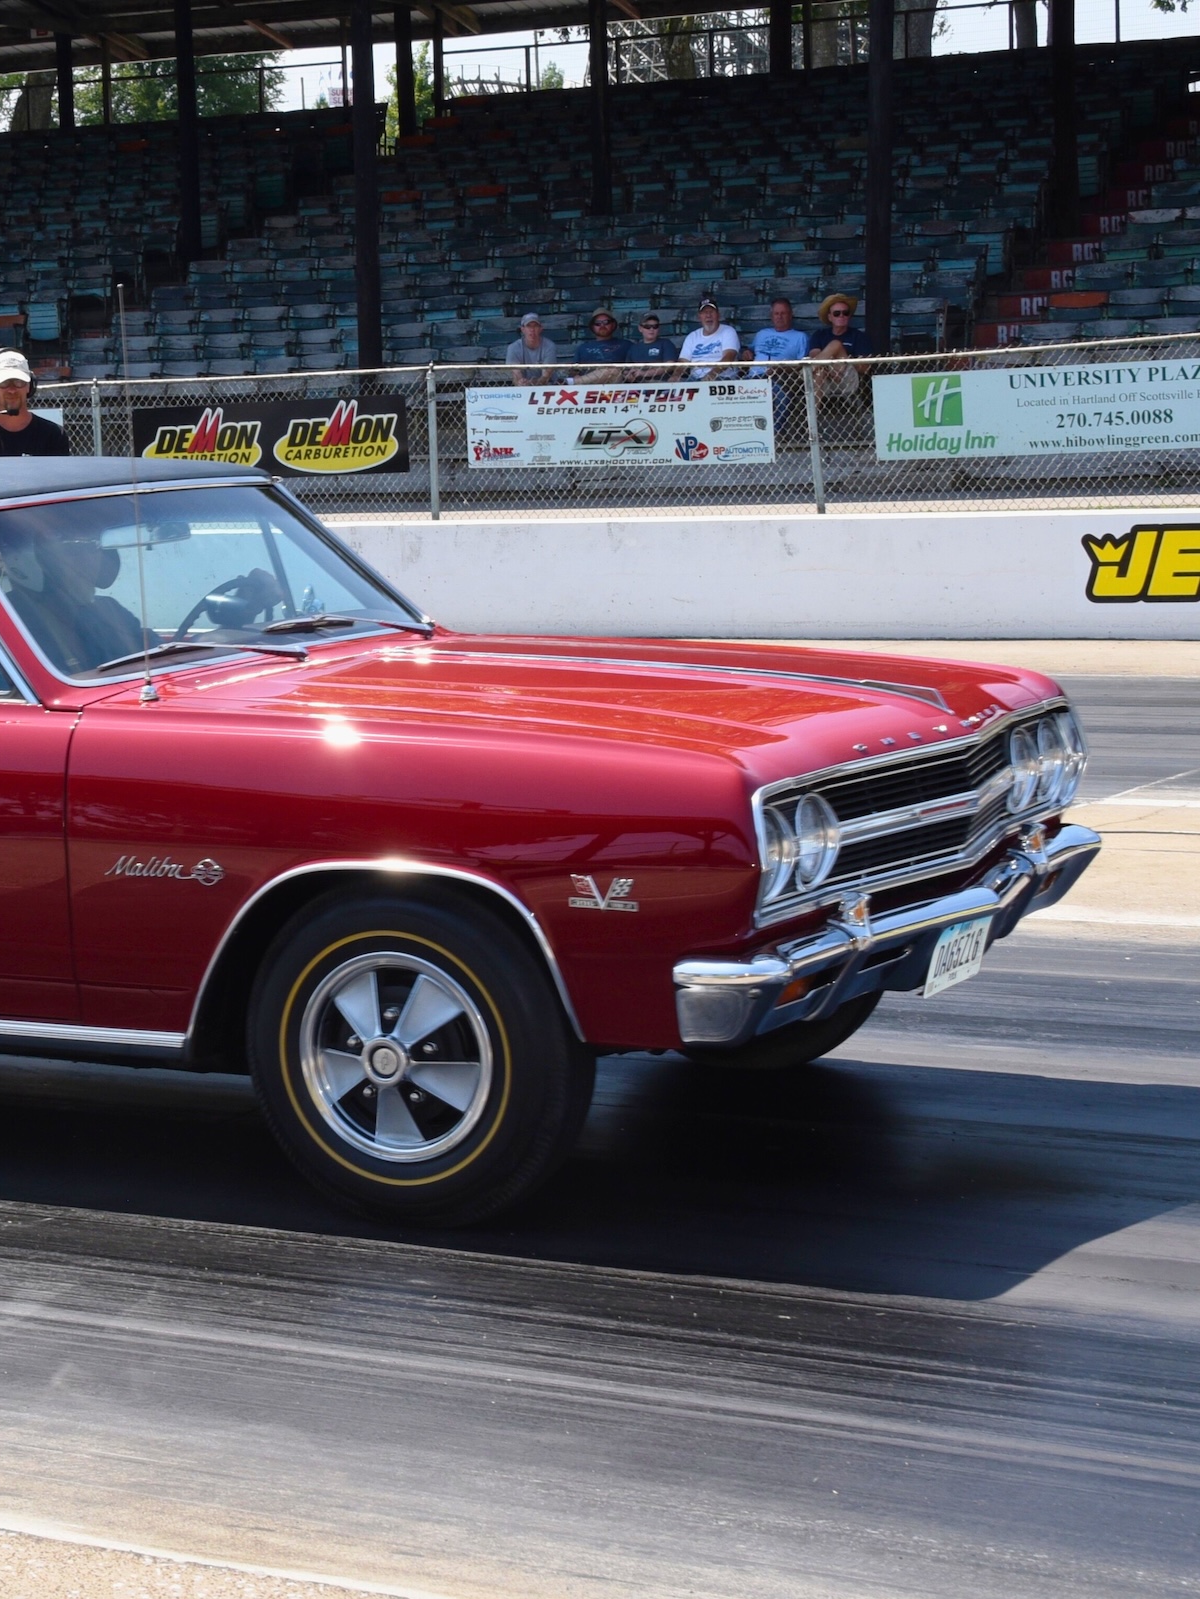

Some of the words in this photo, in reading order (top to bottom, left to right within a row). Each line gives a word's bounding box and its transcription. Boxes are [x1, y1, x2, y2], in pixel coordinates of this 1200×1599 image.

[1009, 368, 1142, 389] UNIVERSITY
[528, 389, 580, 405] LTX
[584, 388, 699, 404] SHOOTOUT
[709, 385, 736, 396] BDB
[738, 386, 767, 397] Racing
[1016, 397, 1056, 408] Located
[1059, 397, 1069, 406] in
[1072, 393, 1116, 405] Hartland
[1119, 392, 1137, 403] Off
[1139, 389, 1193, 402] Scottsville
[537, 406, 607, 415] SEPTEMBER
[648, 404, 686, 413] 2019
[1056, 408, 1174, 428] 270.745.0088
[155, 411, 259, 454] DEMON
[286, 405, 396, 447] DEMON
[675, 436, 698, 461] VP
[886, 432, 962, 455] Holiday
[965, 430, 996, 449] Inn
[1029, 433, 1200, 449] www.hibowlinggreen.com
[284, 445, 388, 461] CARBURETION
[560, 458, 672, 466] WWW.LTXSHOOTOUT.COM
[104, 856, 186, 879] Malibu
